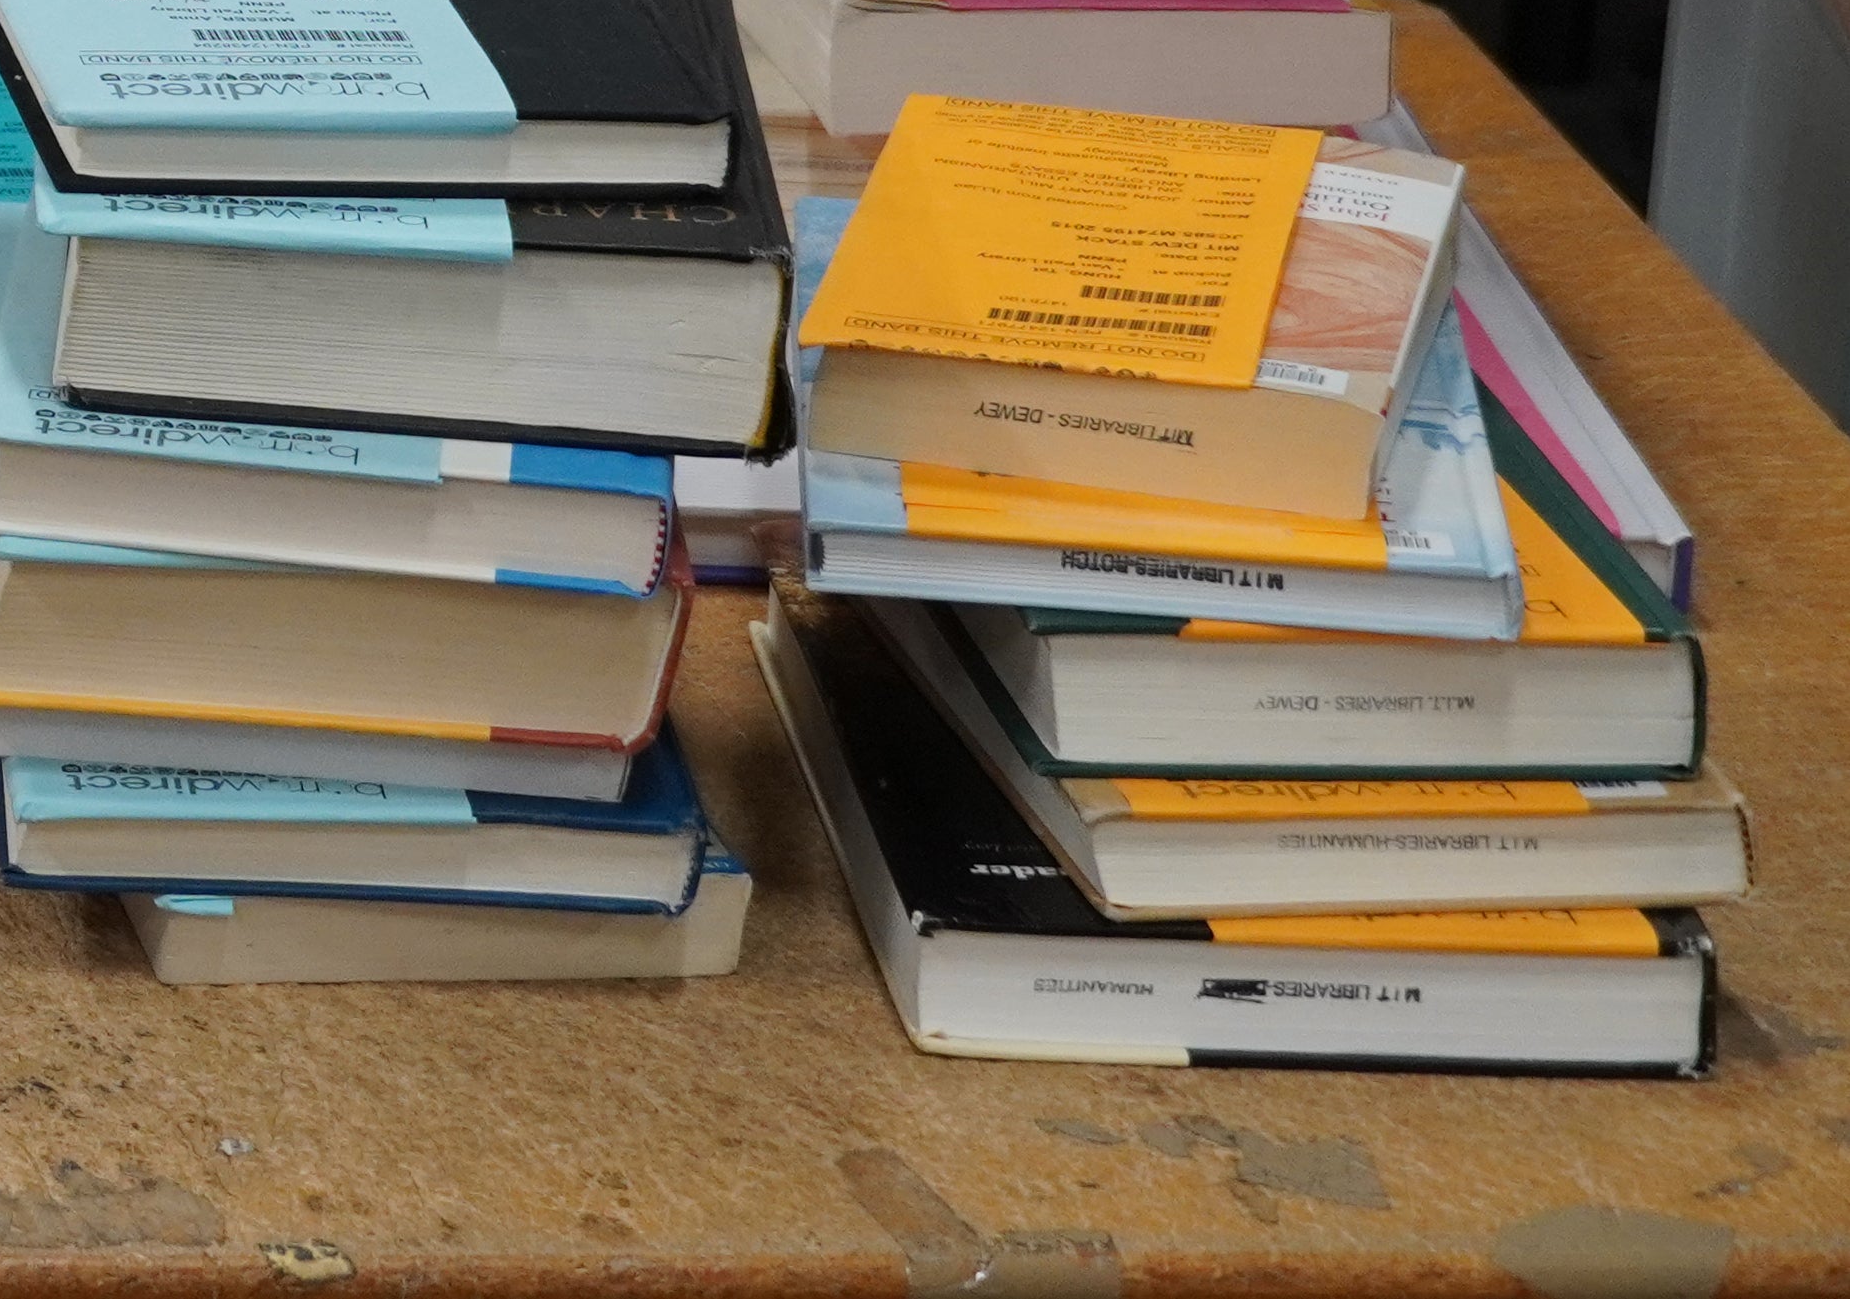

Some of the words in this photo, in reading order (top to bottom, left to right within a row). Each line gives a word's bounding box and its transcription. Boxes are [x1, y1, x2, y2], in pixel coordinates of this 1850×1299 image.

[87, 55, 151, 63] BAND
[157, 55, 208, 63] THIS
[217, 55, 317, 63] REMOVE
[326, 55, 372, 63] NOT
[378, 55, 413, 63] DO
[107, 81, 430, 101] borrowdirect
[1353, 199, 1390, 210] On
[1076, 235, 1133, 244] STACK
[1140, 239, 1198, 249] DEW
[1078, 254, 1127, 263] PENN
[853, 318, 920, 332] BAND
[928, 327, 981, 340] THIS
[991, 335, 1095, 350] REMOVE
[1104, 344, 1153, 356] NOT
[1160, 349, 1198, 360] DO
[974, 402, 1042, 423] DEWEY
[1058, 413, 1156, 438] LIBRARIES
[36, 418, 358, 465] borrowdirect
[1255, 696, 1318, 711] DEWEY
[1336, 696, 1423, 711] LIBRARIES
[66, 775, 386, 799] borrowdirect
[1034, 978, 1154, 995] HUMANITIES
